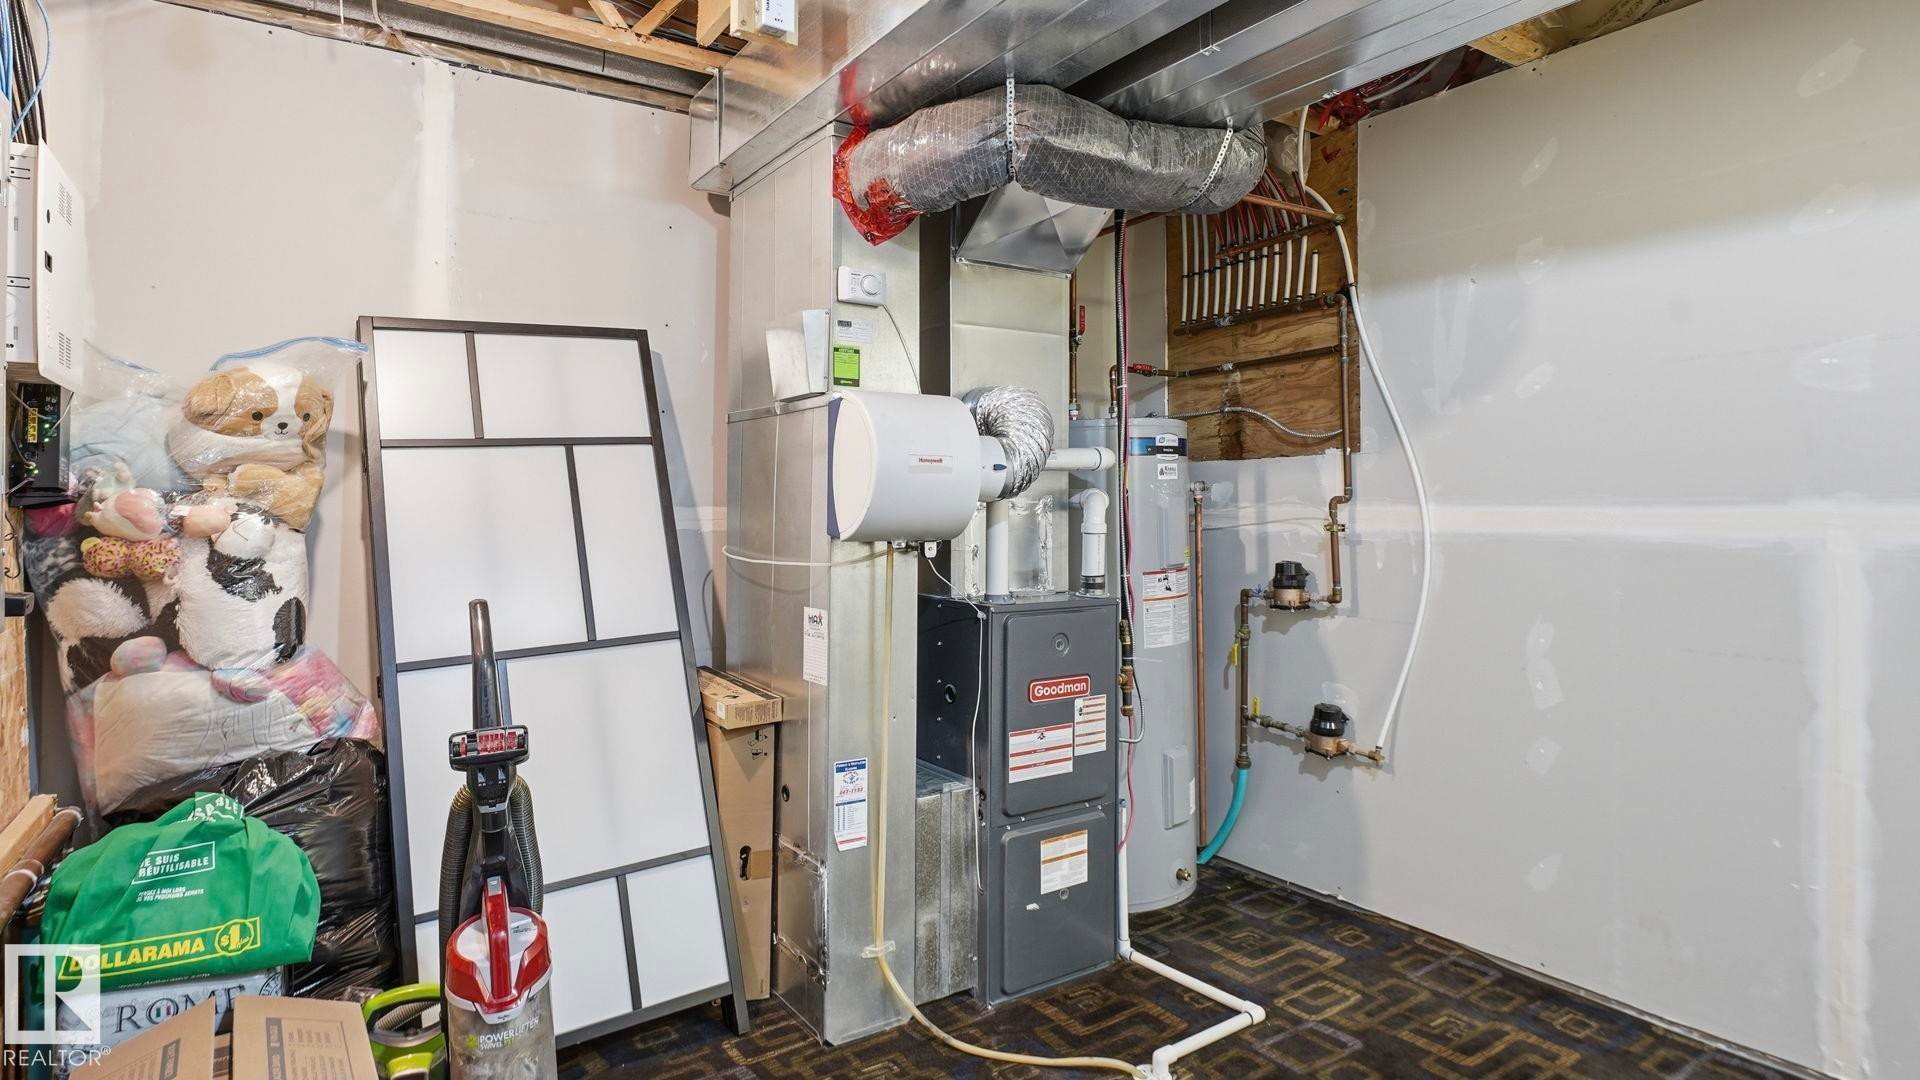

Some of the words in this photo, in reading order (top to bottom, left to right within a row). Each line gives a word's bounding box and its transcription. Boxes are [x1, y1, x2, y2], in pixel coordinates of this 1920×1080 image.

[1034, 682, 1087, 697] Goodman
[138, 855, 209, 878] RÉUTILISABLE
[155, 853, 180, 866] SUIS
[69, 937, 206, 972] DOLLARAMA
